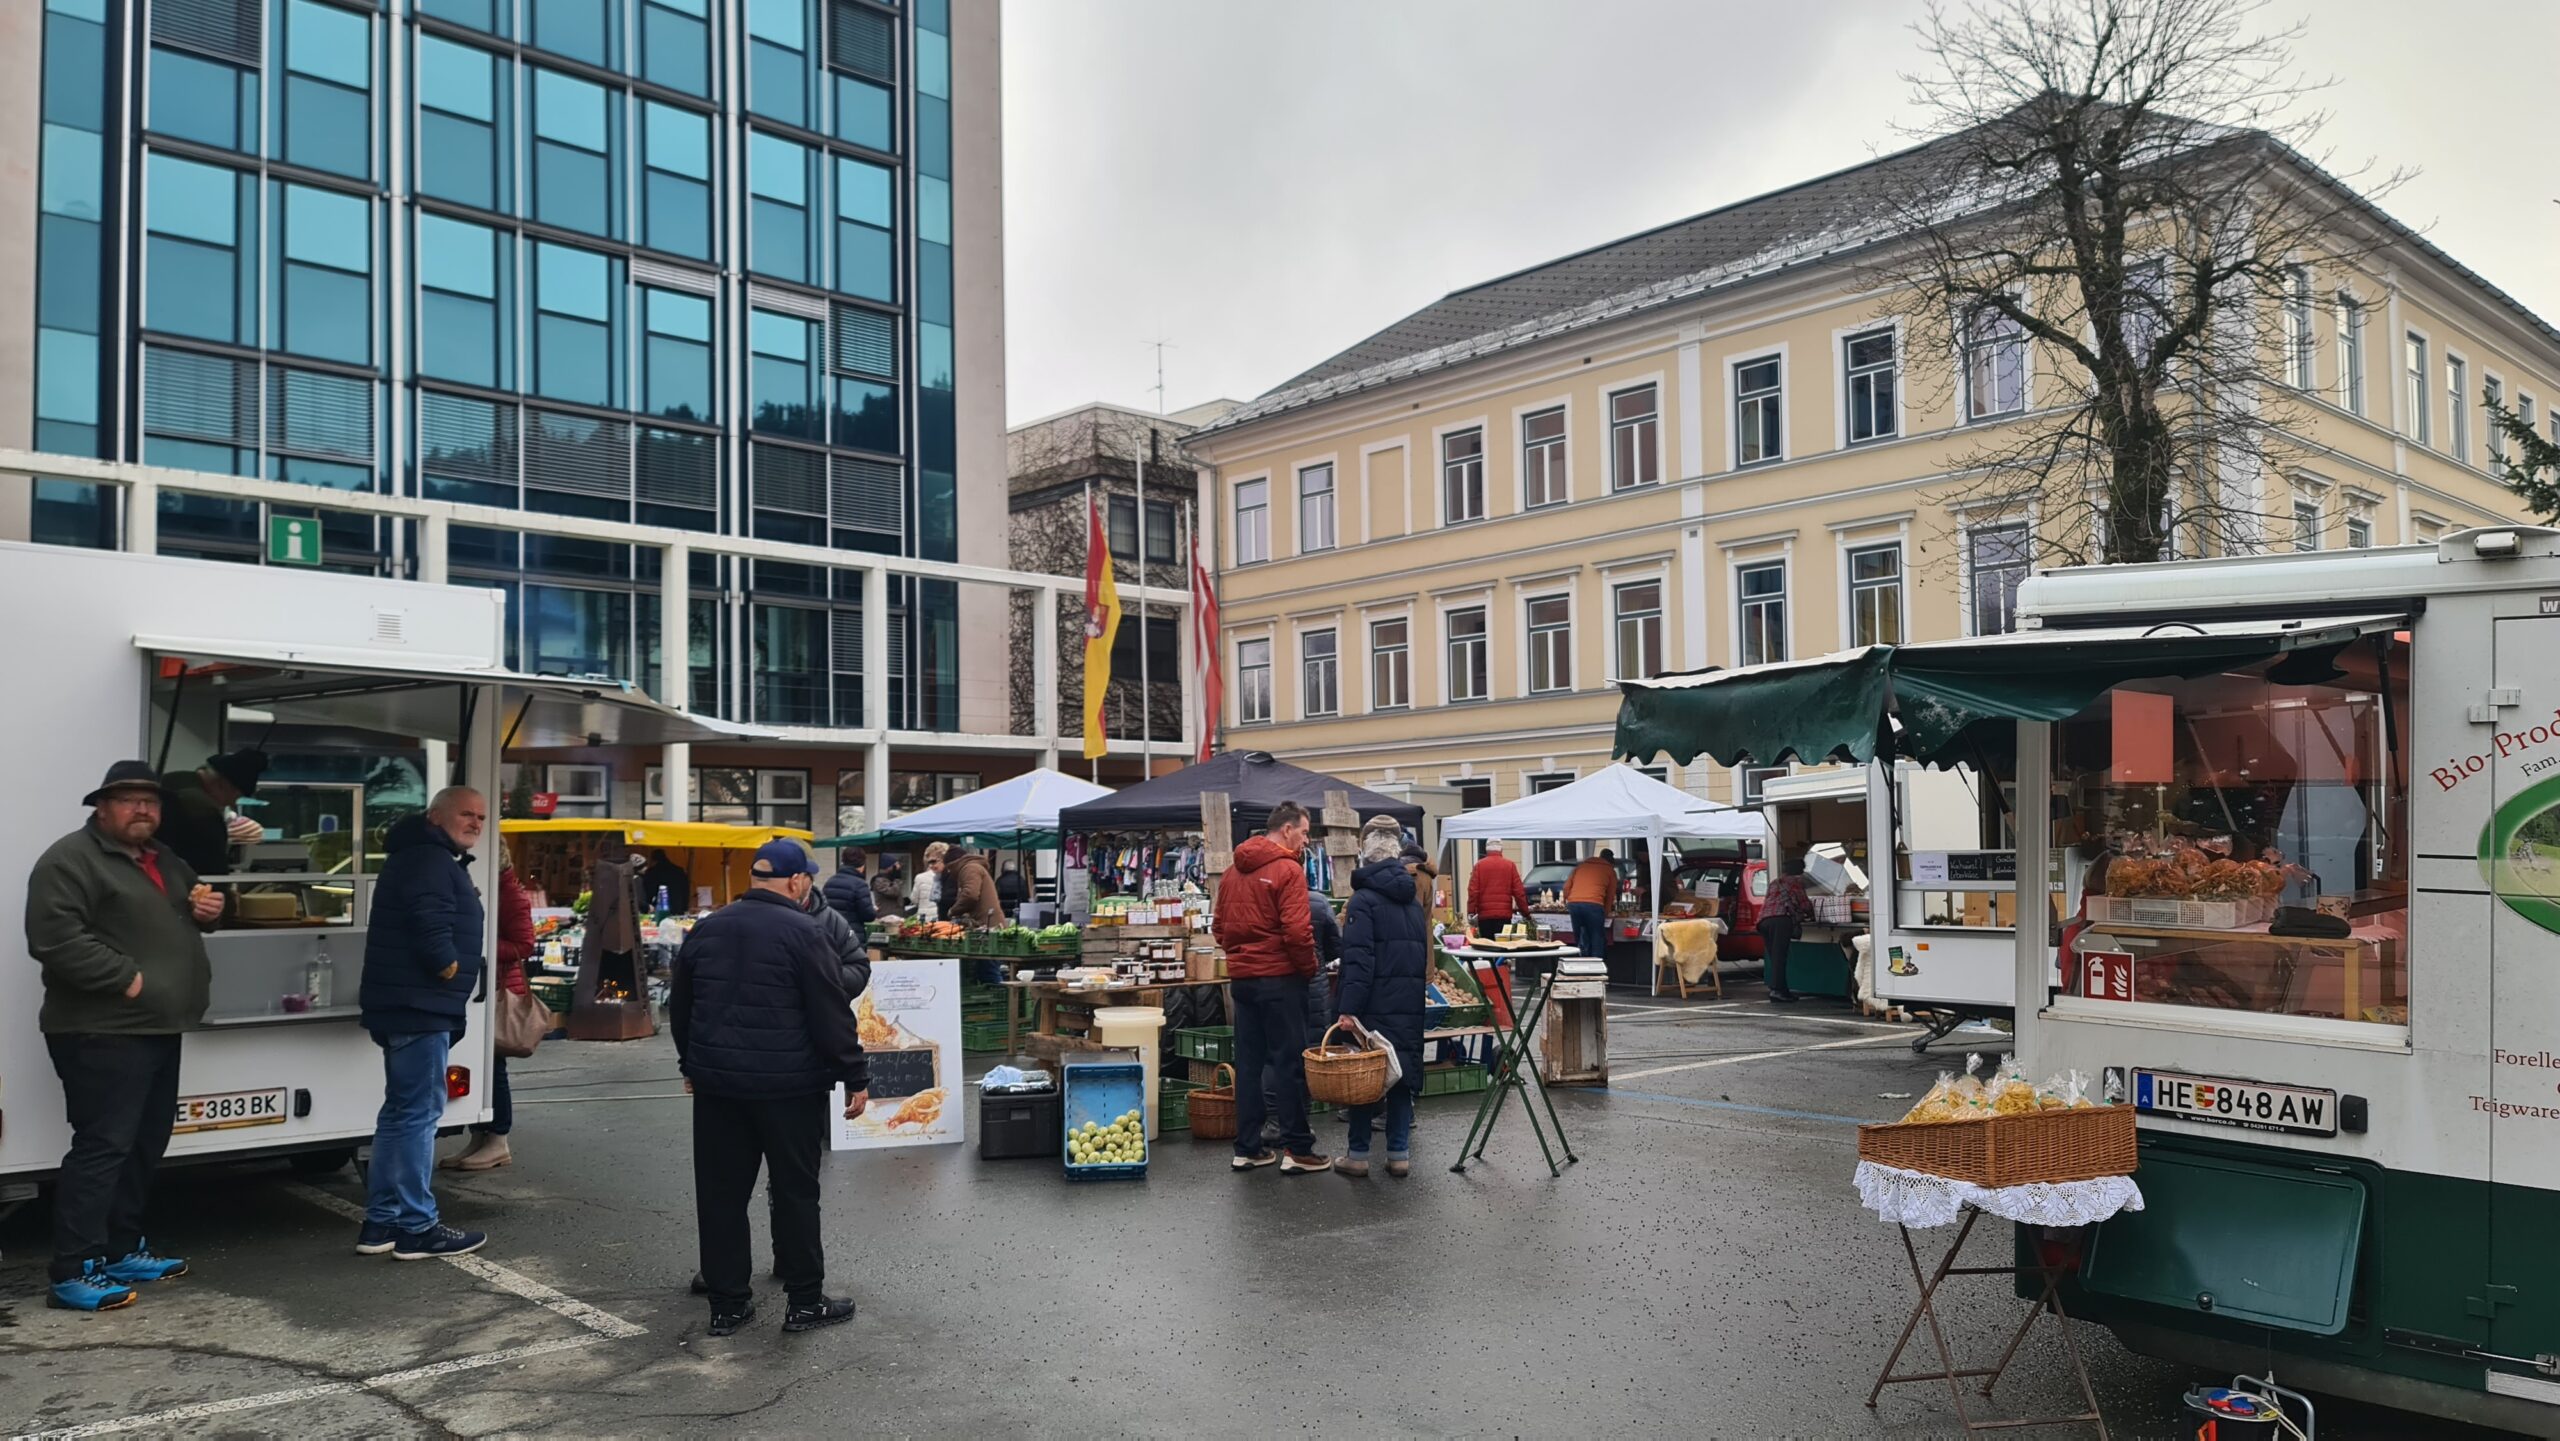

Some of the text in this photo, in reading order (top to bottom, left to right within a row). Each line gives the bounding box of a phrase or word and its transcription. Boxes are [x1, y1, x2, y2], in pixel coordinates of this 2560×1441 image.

[2141, 1095, 2149, 1103] A
[2158, 1079, 2192, 1109] HE
[176, 1103, 188, 1122] E
[206, 1098, 245, 1119] 383
[2468, 1095, 2560, 1119] Teigware
